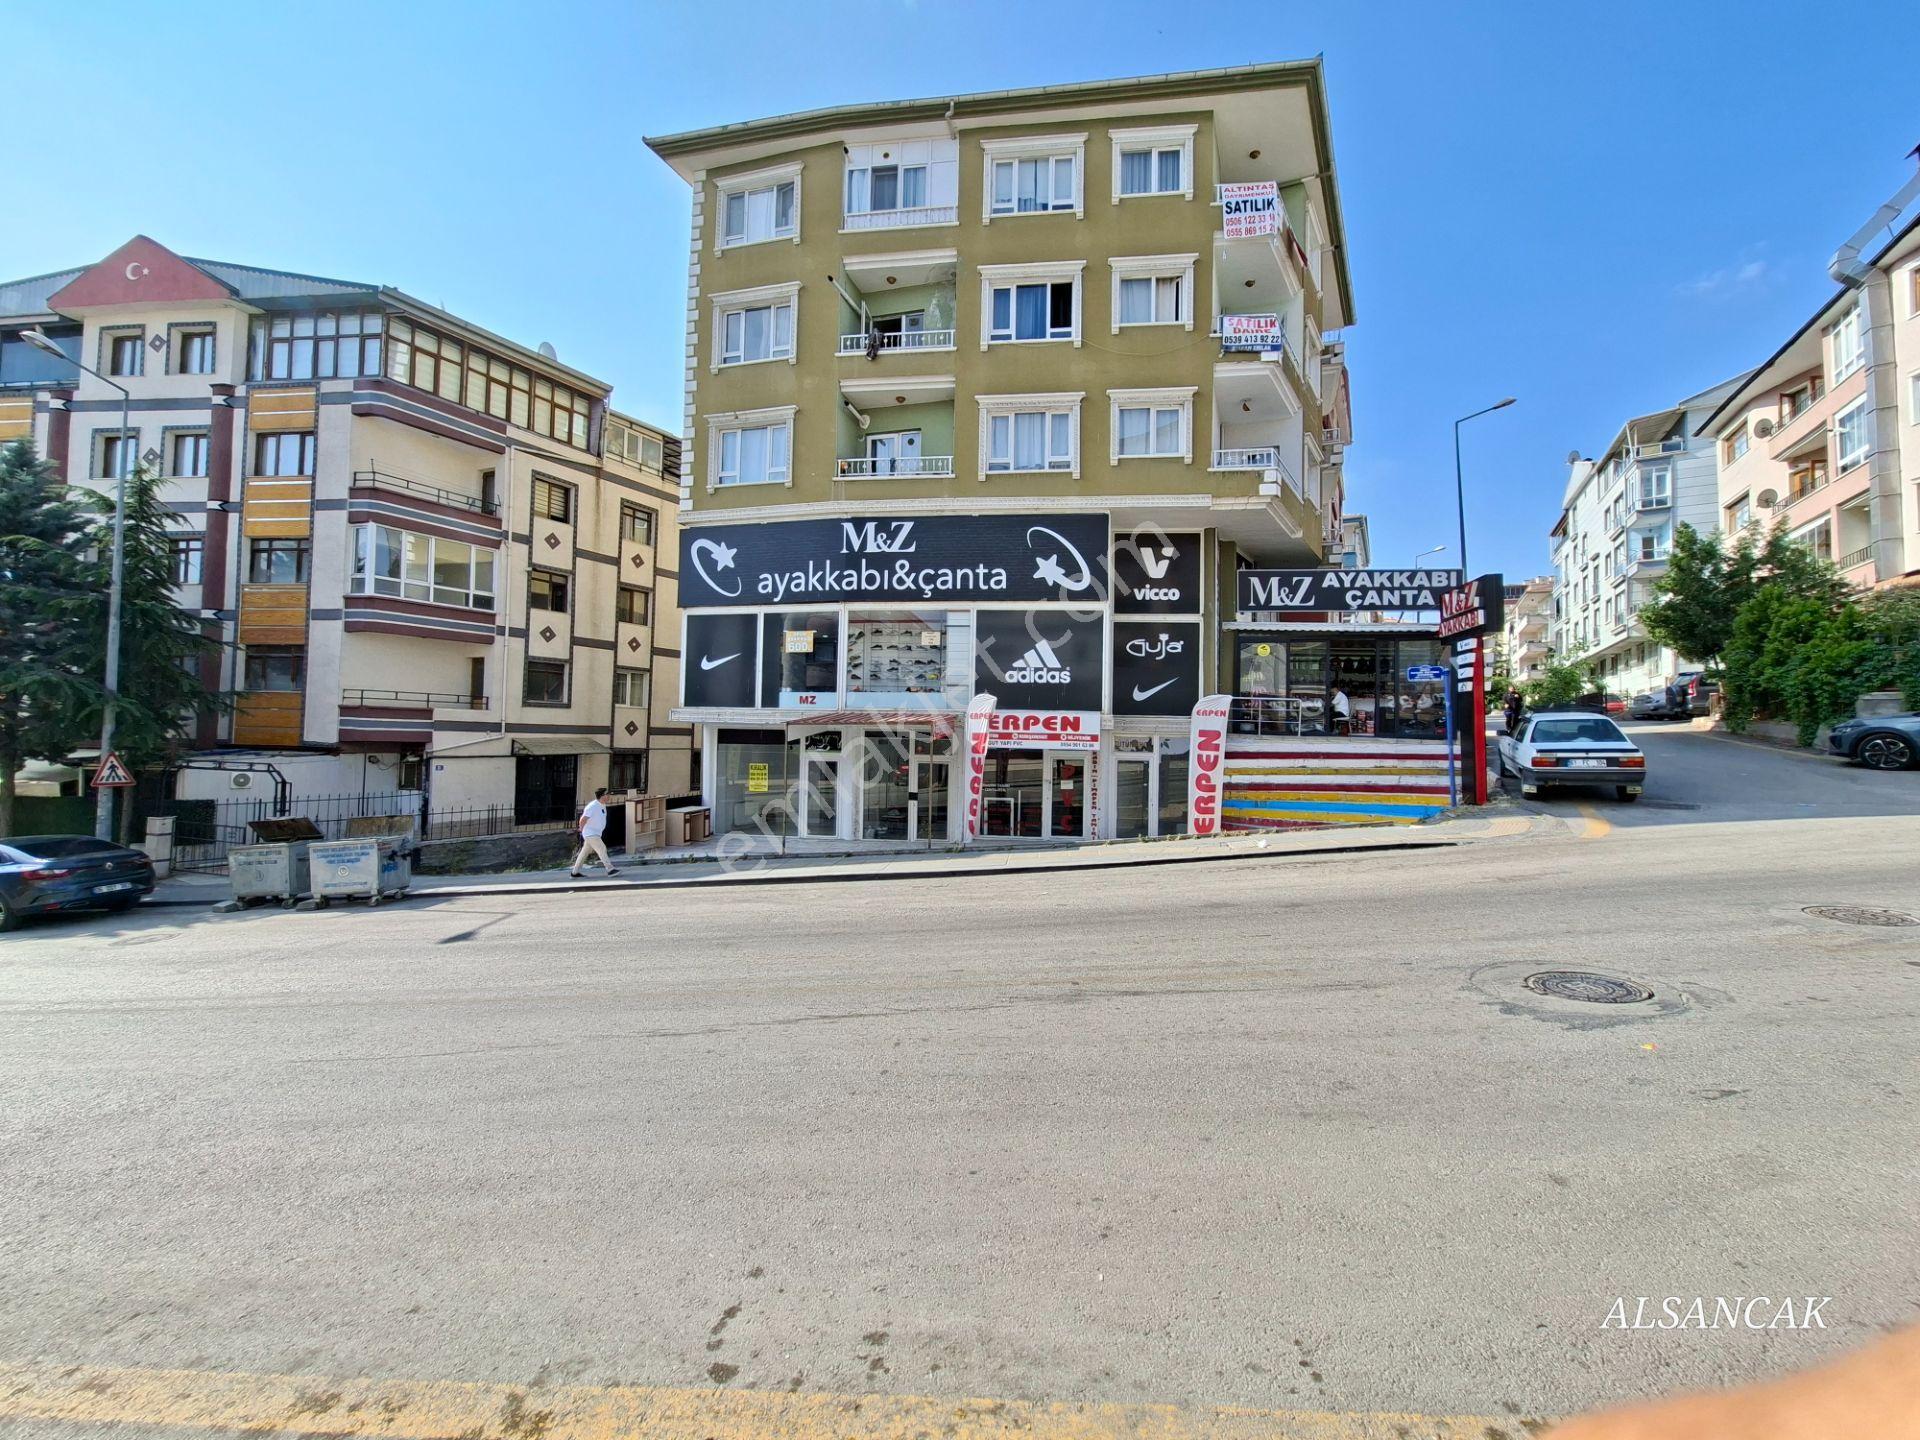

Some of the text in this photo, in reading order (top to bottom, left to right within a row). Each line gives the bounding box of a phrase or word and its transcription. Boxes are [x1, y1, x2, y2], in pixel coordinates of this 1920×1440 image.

[1225, 198, 1275, 214] SATILIK
[1244, 215, 1256, 225] 122
[1228, 318, 1276, 328] SATILIK
[1224, 334, 1280, 344] 0539 413 92 22
[840, 521, 916, 553] M&Z
[757, 558, 1007, 602] ayakkabı&çanta
[1321, 572, 1457, 588] AYAKKABI
[1133, 584, 1180, 600] vicco
[1248, 577, 1315, 607] M&Z
[1345, 590, 1435, 609] ÇANTA
[1442, 581, 1478, 618] M&Z
[1005, 667, 1071, 684] adidas
[799, 695, 816, 705] MZ
[1196, 709, 1227, 718] ERPEN
[988, 714, 1081, 732] ERPEN
[1194, 729, 1222, 834] ERPEN
